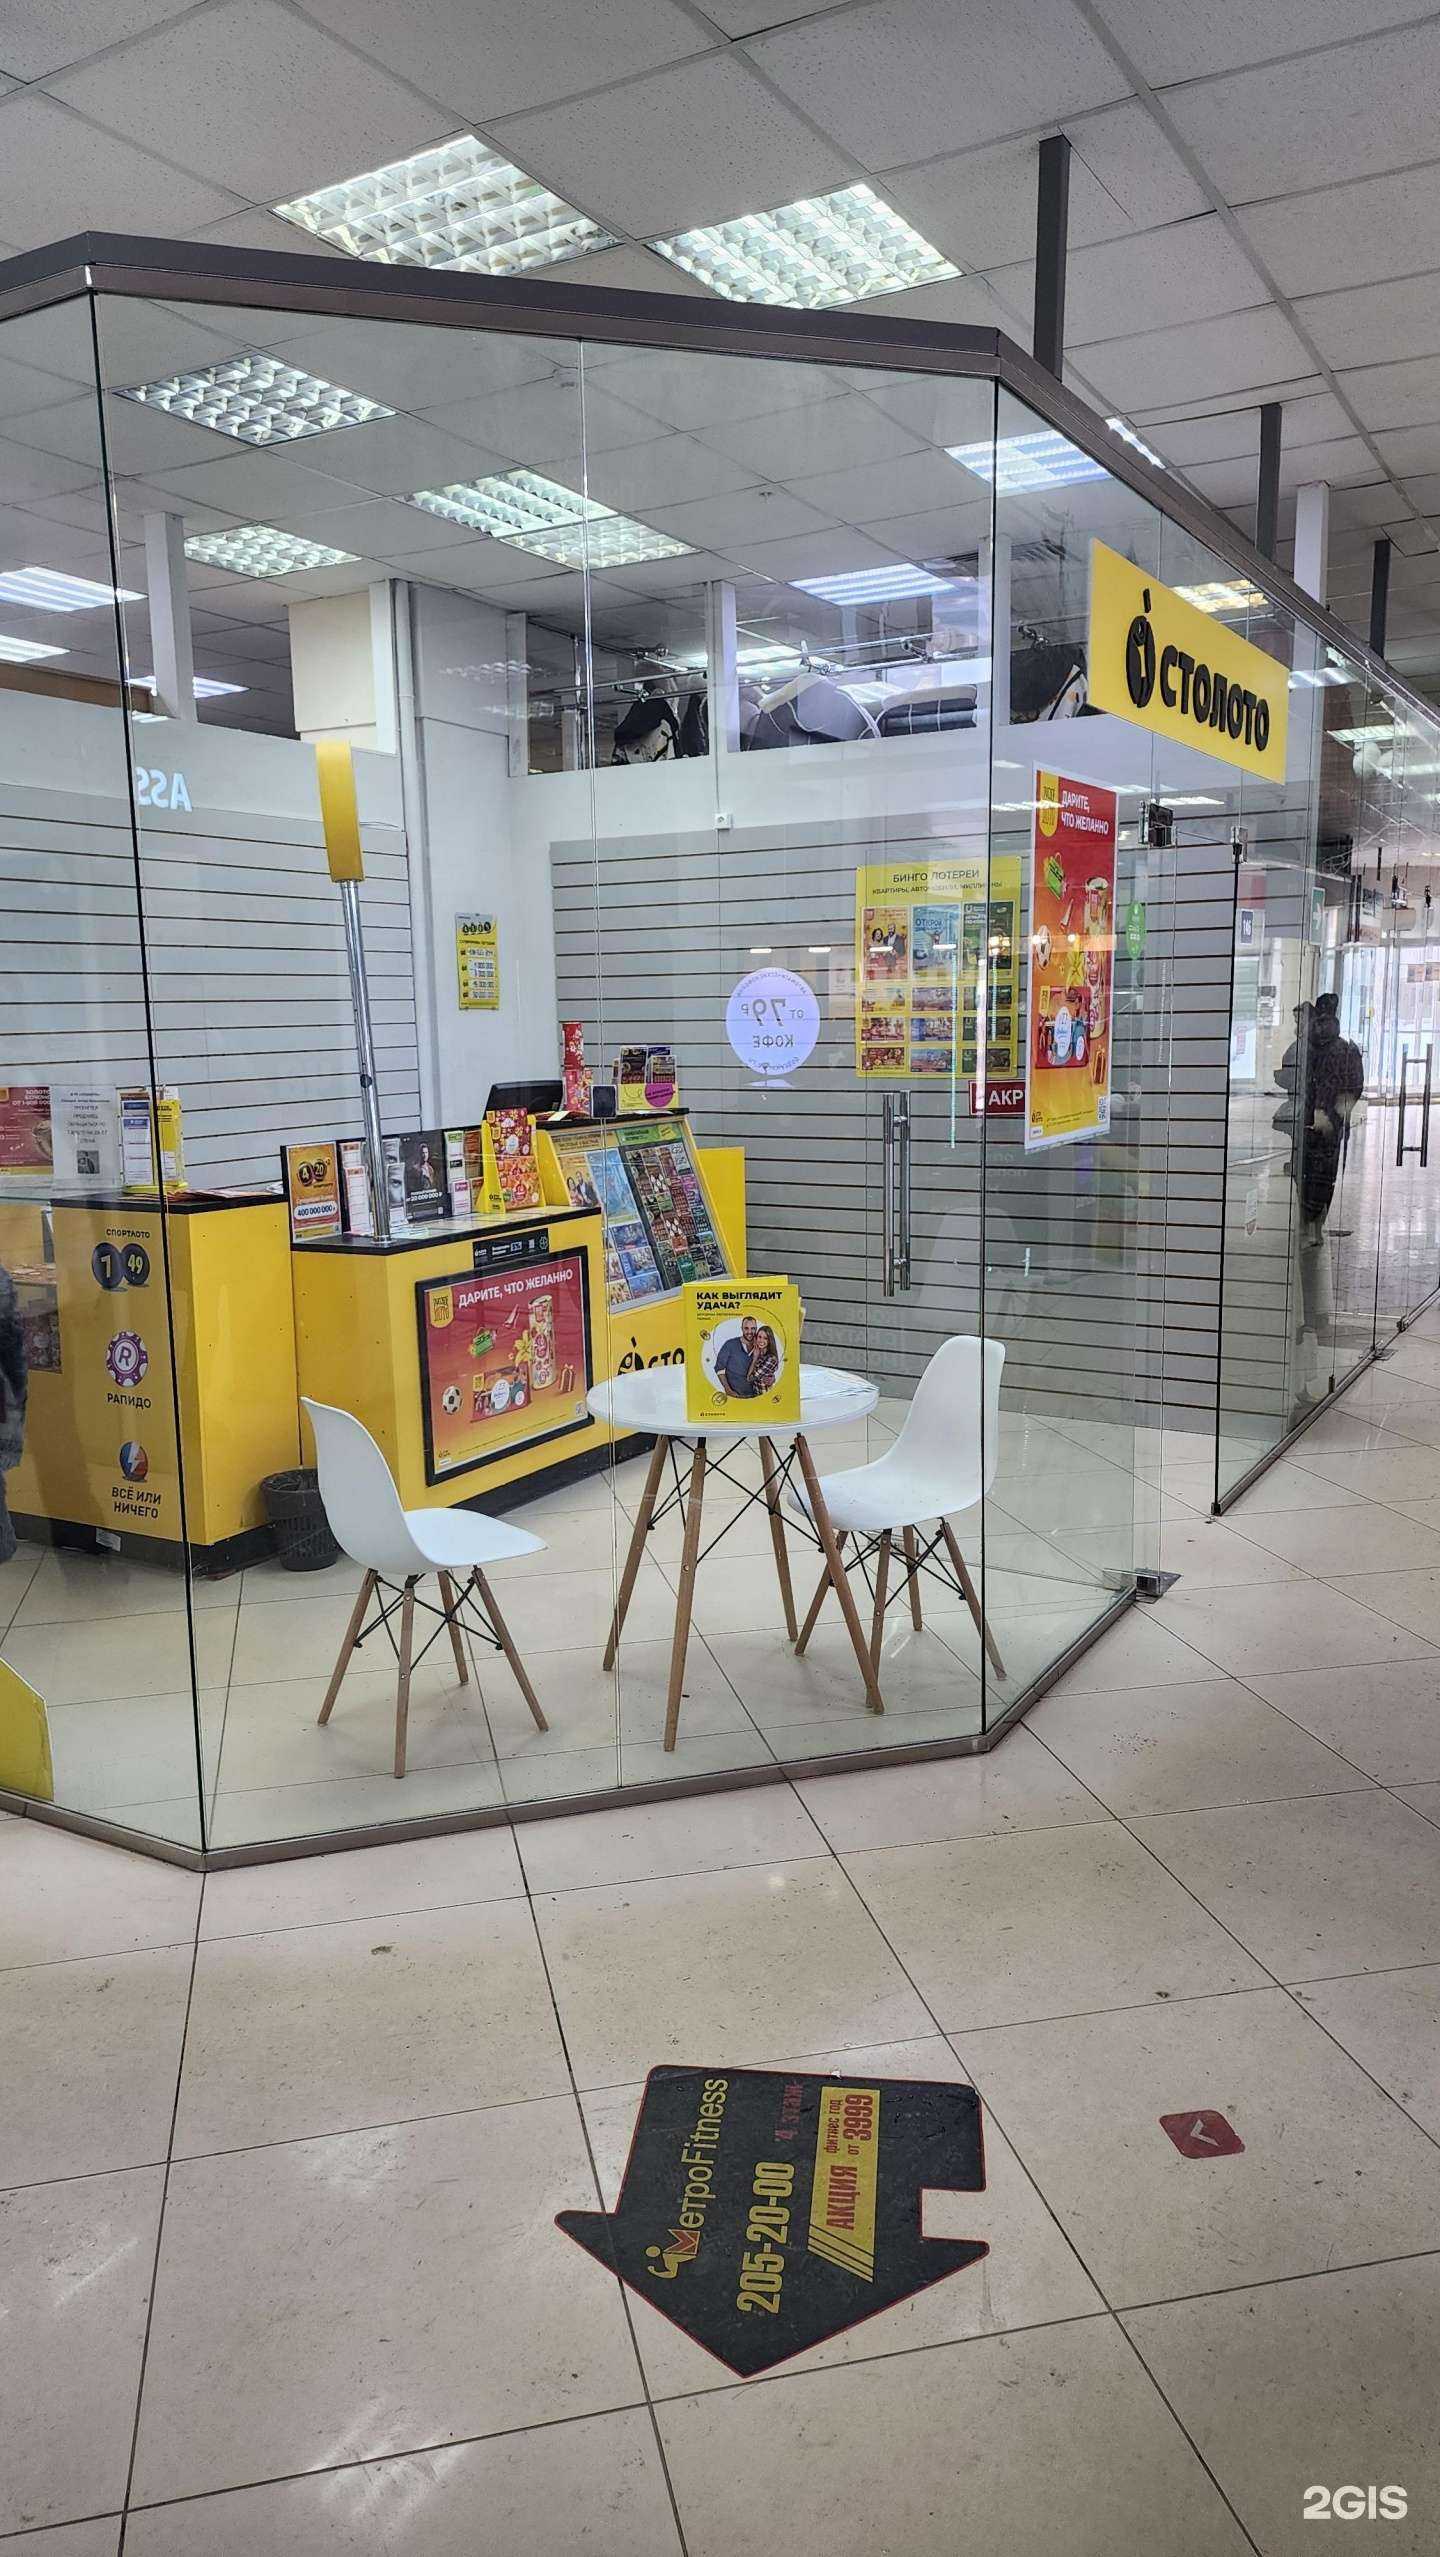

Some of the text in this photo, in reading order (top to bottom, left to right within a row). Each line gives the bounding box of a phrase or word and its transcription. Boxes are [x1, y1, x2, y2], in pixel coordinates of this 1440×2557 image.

[1160, 645, 1270, 751] СТОЛОТО
[1062, 790, 1090, 813] ДАРИТЕ,
[1062, 812, 1109, 834] ЧТО ЖЕЛАННО
[893, 872, 928, 883] БИНГО
[106, 1228, 151, 1238] СПОРТЛОТО
[128, 1254, 144, 1274] 49
[458, 1286, 503, 1308] ДАРИТЕ,
[504, 1282, 524, 1295] ЧТО
[526, 1269, 573, 1291] ЖЕЛАННО
[696, 1292, 782, 1300] КАК ВЫГЛЯДИТ
[696, 1302, 741, 1310] УДАЧА?
[107, 1393, 152, 1410] РАПИДО
[112, 1485, 162, 1505] ВСЁ ИЛИ
[114, 1501, 158, 1519] НИЧЕГО
[824, 2098, 843, 2154] фитнес год
[843, 2094, 874, 2156] от 3999
[826, 2164, 861, 2231] АКЦИЯ
[736, 2161, 796, 2314] 205-20-00
